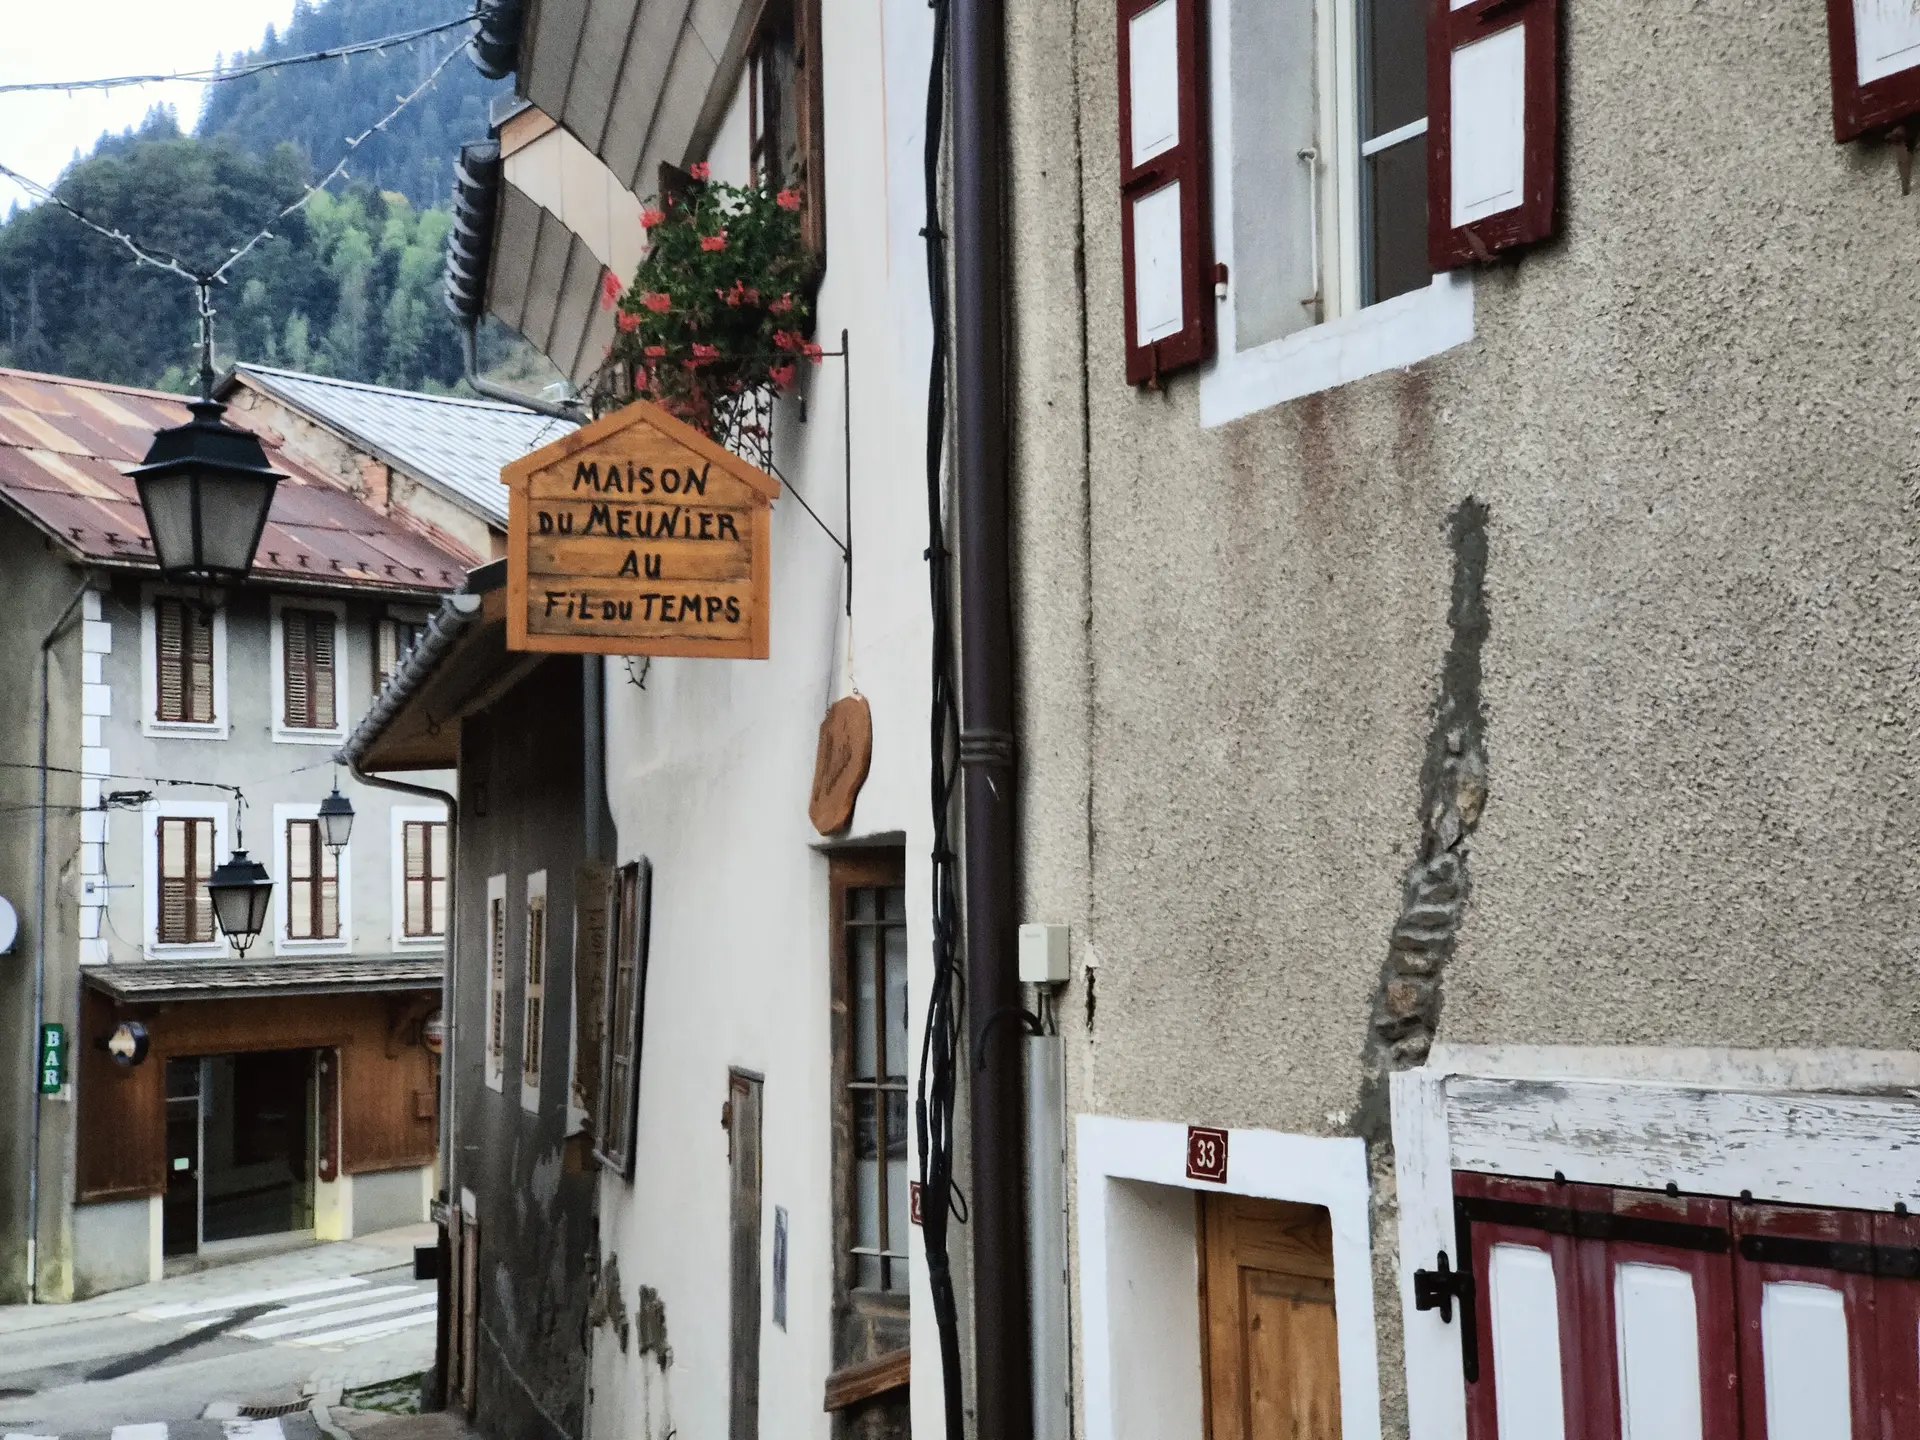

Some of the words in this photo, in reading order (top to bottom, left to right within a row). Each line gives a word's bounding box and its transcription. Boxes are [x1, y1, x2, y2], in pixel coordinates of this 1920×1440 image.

[538, 511, 573, 535] DU
[617, 550, 662, 580] AU
[602, 600, 633, 622] DU
[640, 593, 741, 624] TEMPS
[43, 1030, 60, 1086] BAR
[1196, 1139, 1216, 1169] 33
